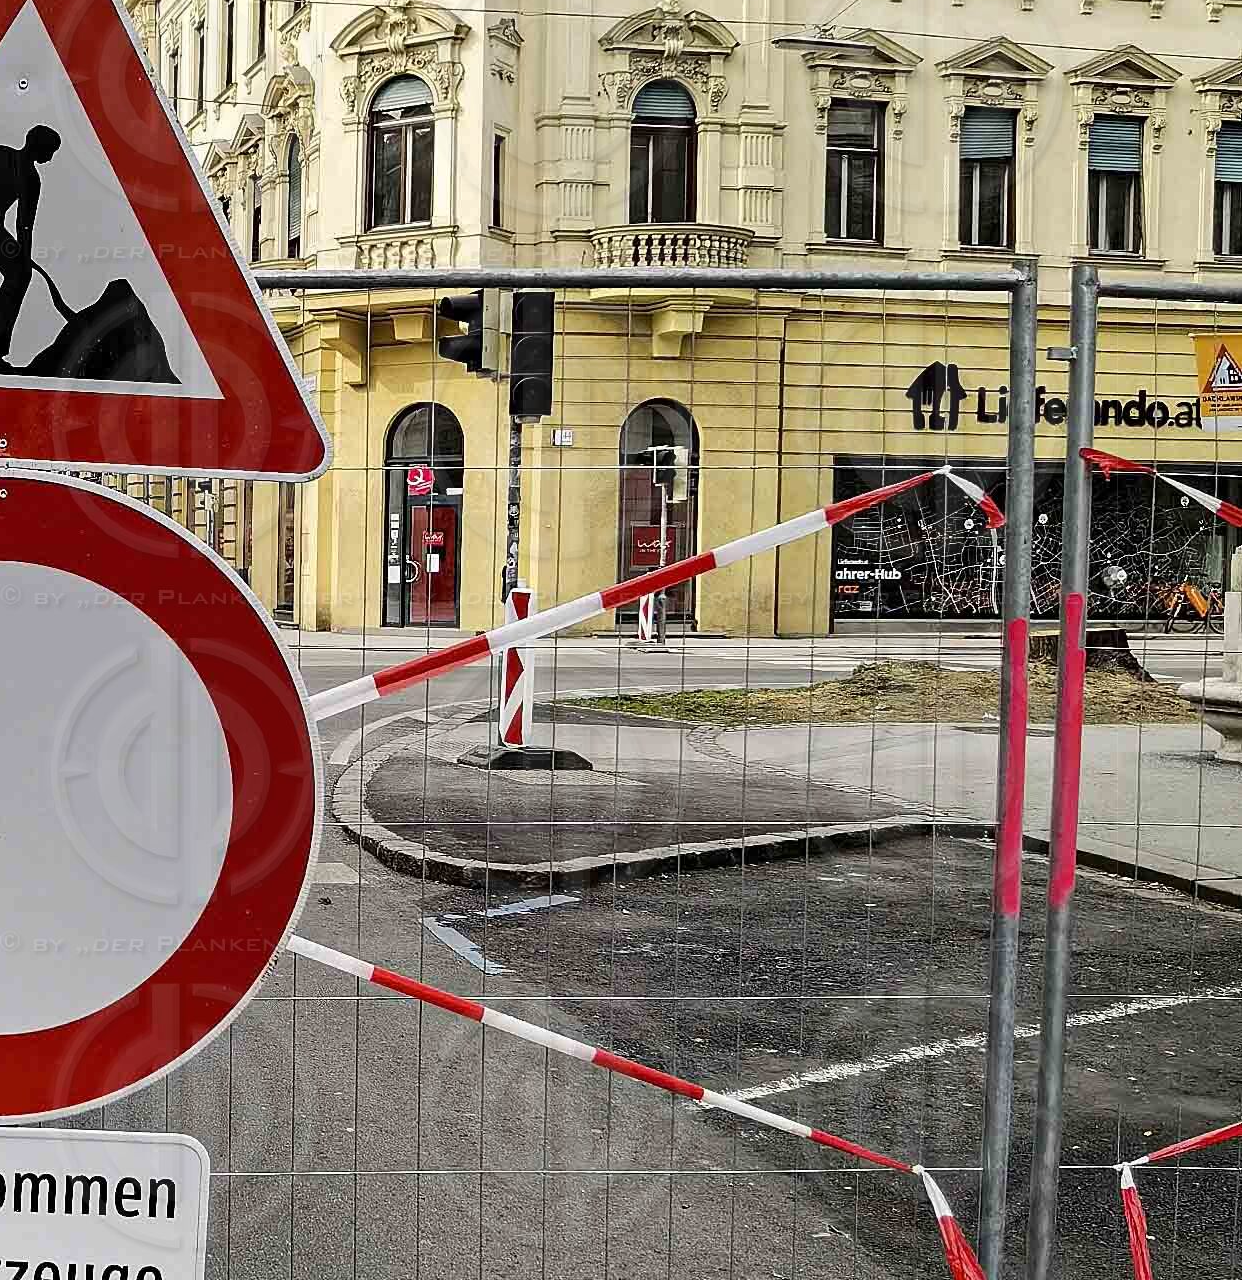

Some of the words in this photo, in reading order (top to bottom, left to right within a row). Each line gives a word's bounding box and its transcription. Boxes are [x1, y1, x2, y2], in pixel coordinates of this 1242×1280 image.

[977, 386, 1201, 427] Lifendo.at
[835, 568, 902, 579] ahrer-Hub
[835, 585, 859, 593] raz
